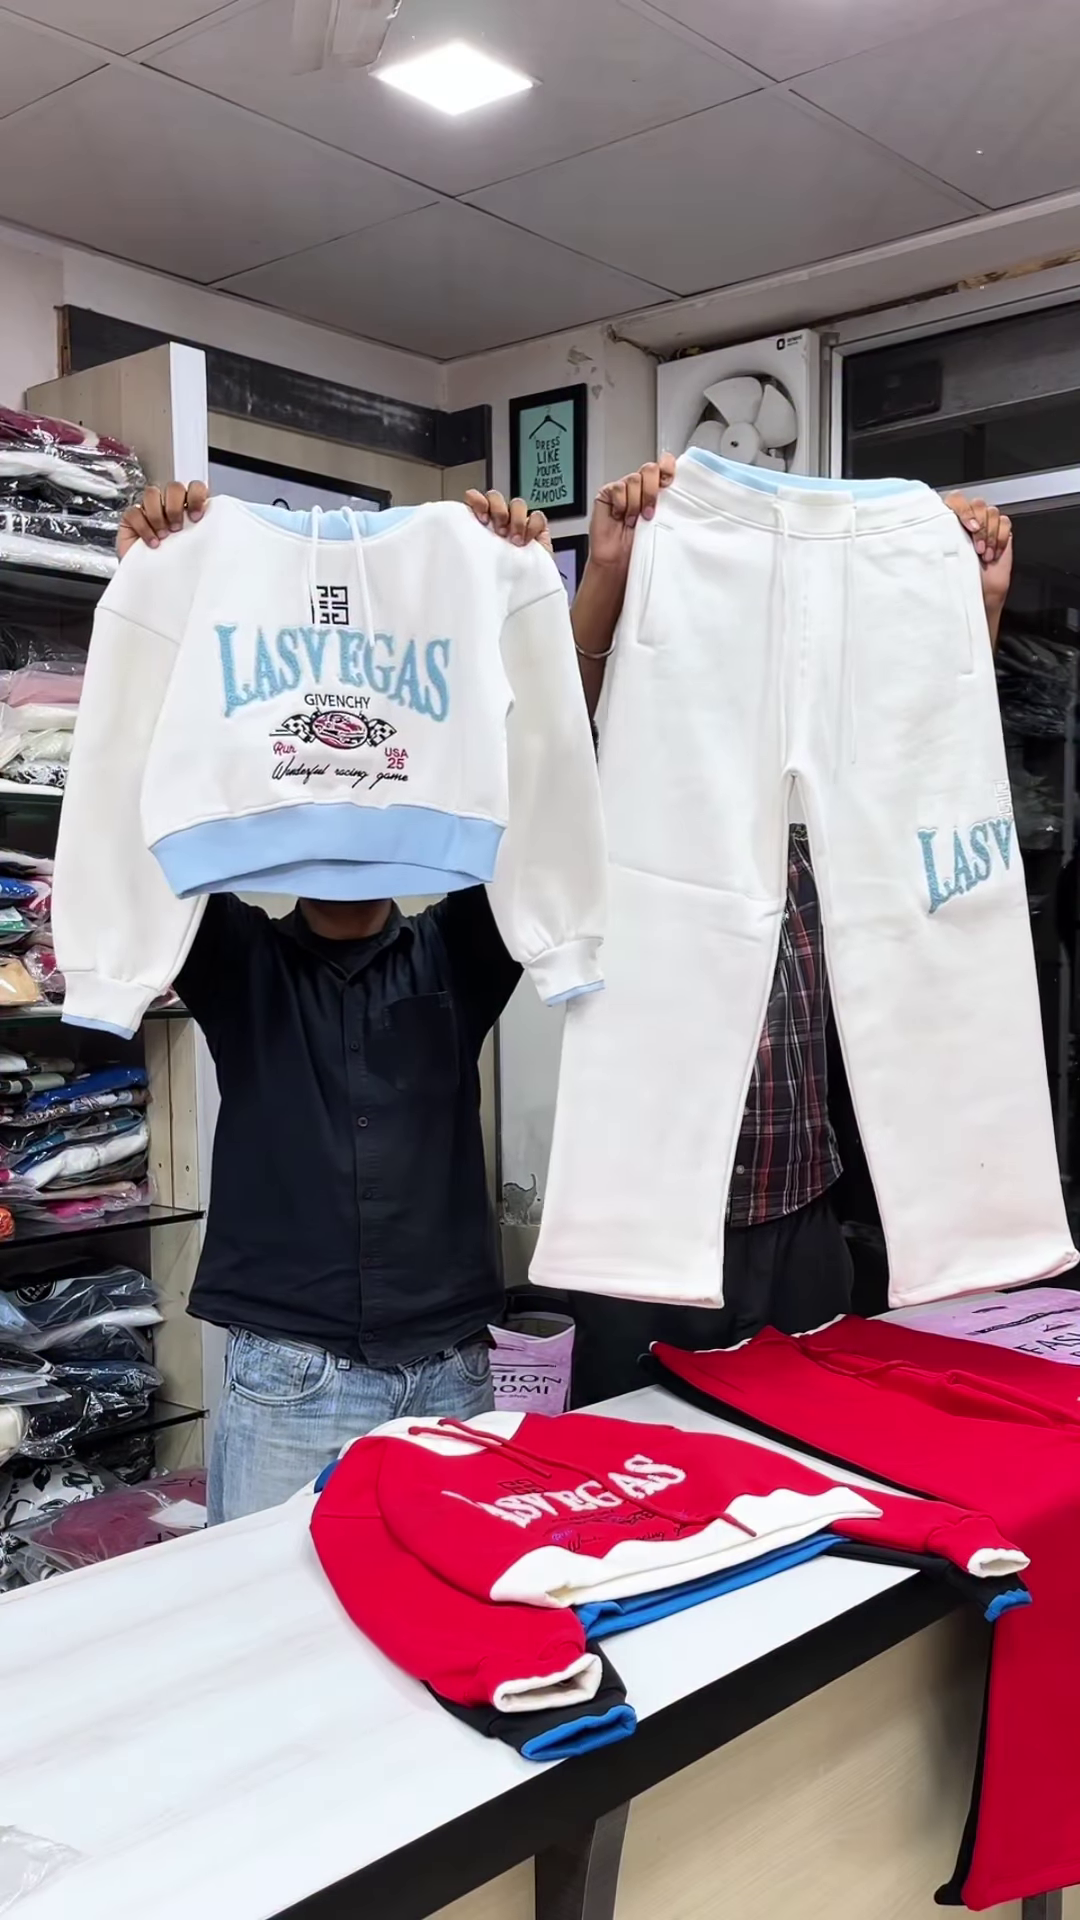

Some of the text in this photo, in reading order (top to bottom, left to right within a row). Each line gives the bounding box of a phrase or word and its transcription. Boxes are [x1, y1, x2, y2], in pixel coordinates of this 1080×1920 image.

[536, 436, 560, 450] DRESS
[537, 448, 560, 464] LIKE
[533, 474, 563, 488] ALREADY
[530, 485, 567, 503] FAMOUS
[304, 693, 370, 709] GIVENCHY
[385, 747, 409, 759] USA
[387, 757, 405, 770] 25
[334, 767, 369, 788] racing
[368, 772, 408, 790] game
